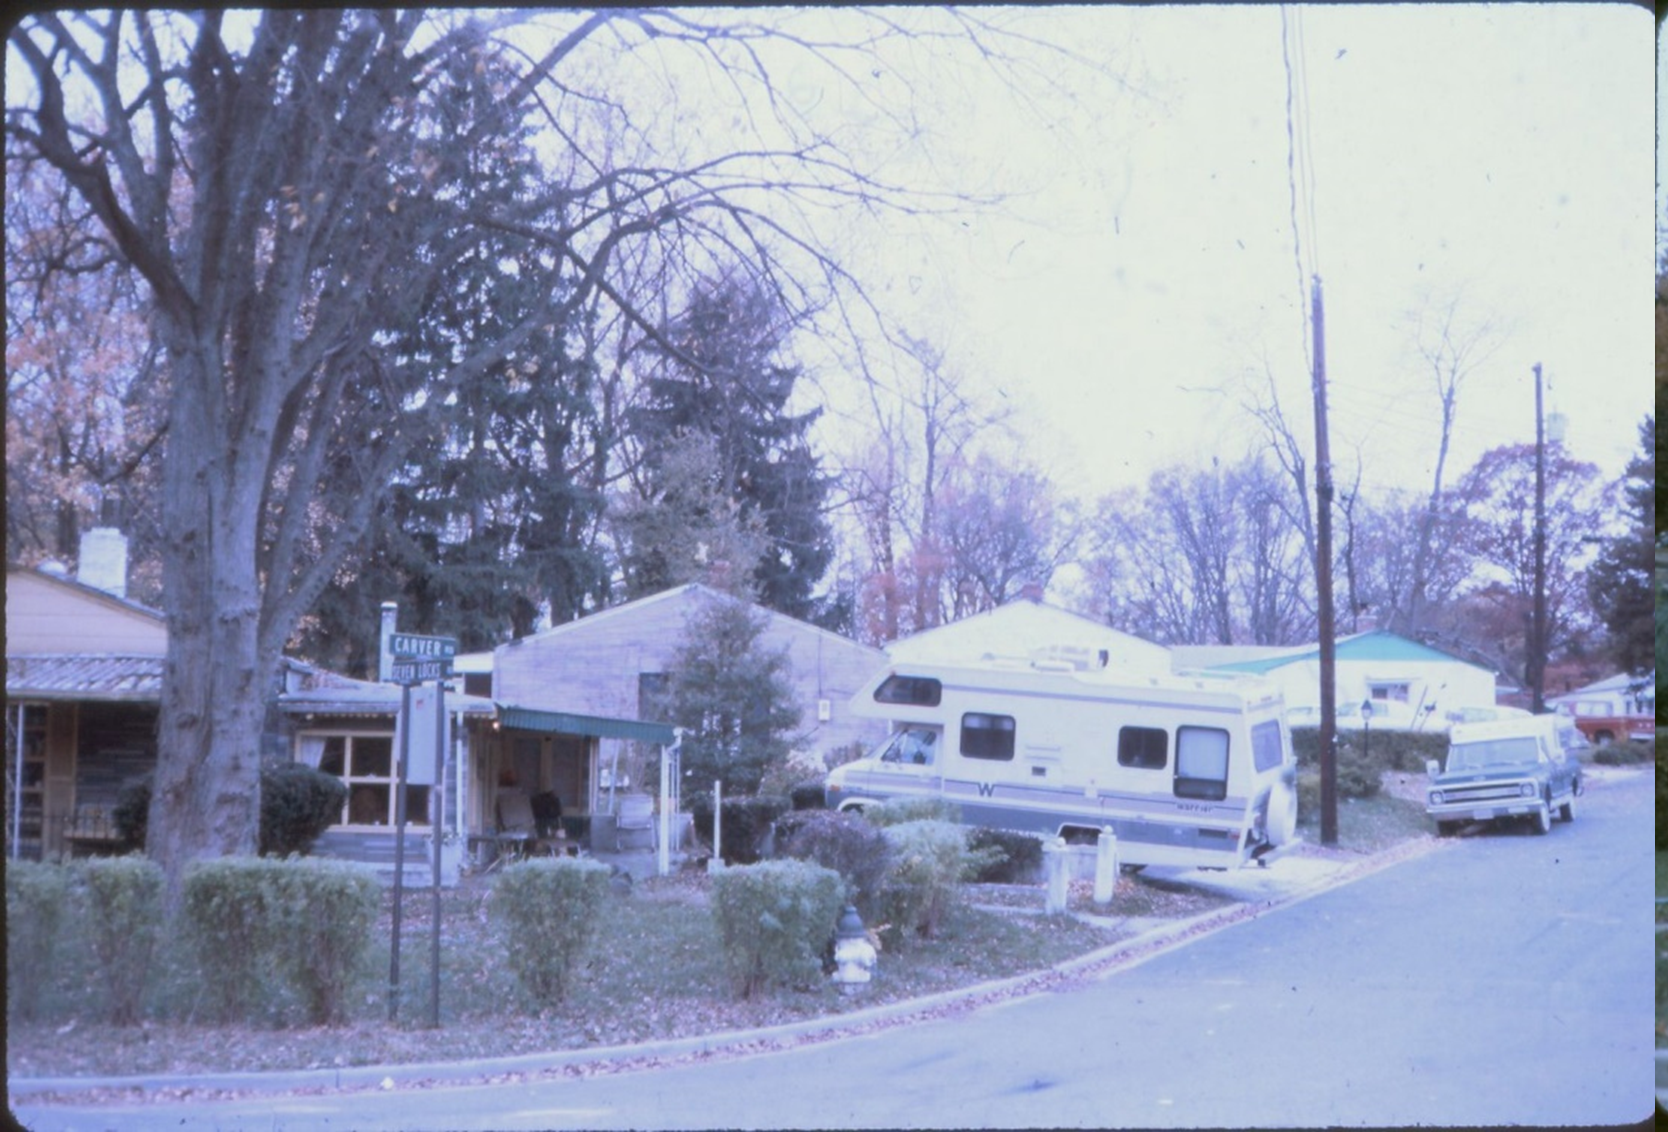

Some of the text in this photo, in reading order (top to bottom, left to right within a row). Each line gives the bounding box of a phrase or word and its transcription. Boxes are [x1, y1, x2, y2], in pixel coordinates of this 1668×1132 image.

[395, 637, 441, 656] CARVER
[418, 662, 441, 679] LOCKS
[978, 782, 995, 798] W
